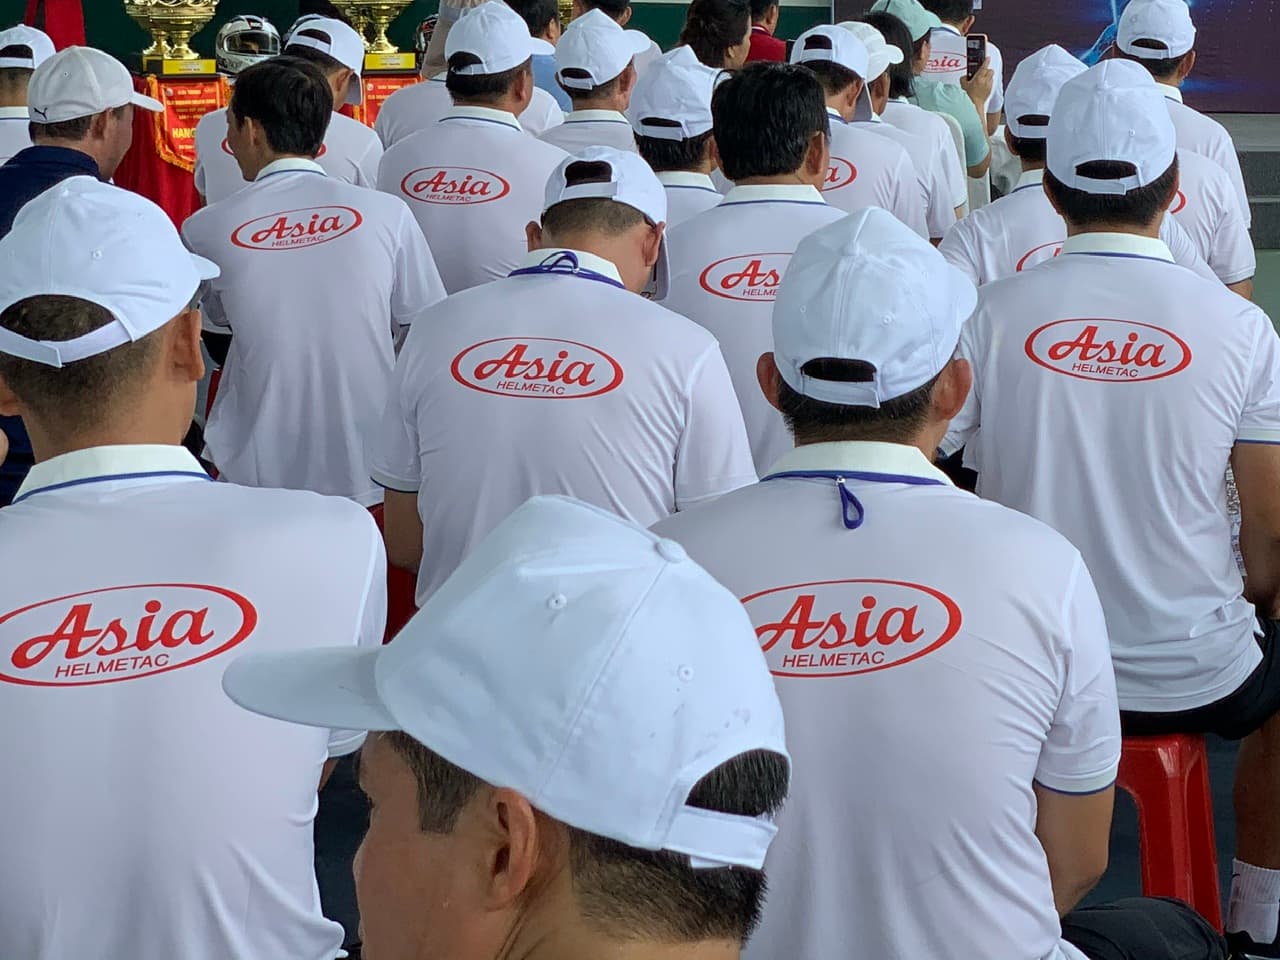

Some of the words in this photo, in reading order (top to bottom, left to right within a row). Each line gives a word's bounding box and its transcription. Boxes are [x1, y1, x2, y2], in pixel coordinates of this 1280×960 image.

[928, 55, 961, 68] sia
[413, 171, 491, 196] Asia
[425, 193, 471, 202] HELMETAC
[251, 213, 345, 243] Asia
[271, 234, 325, 248] HELMETAC
[720, 259, 780, 289] As
[1048, 325, 1167, 368] Asia
[474, 343, 597, 386] Asia
[1072, 362, 1139, 378] HELMETAC
[496, 379, 565, 396] HELMETAC
[10, 599, 215, 669] Asia
[756, 594, 925, 649] Asia
[54, 653, 170, 680] HELMETAC
[782, 651, 885, 669] HELMETAC
